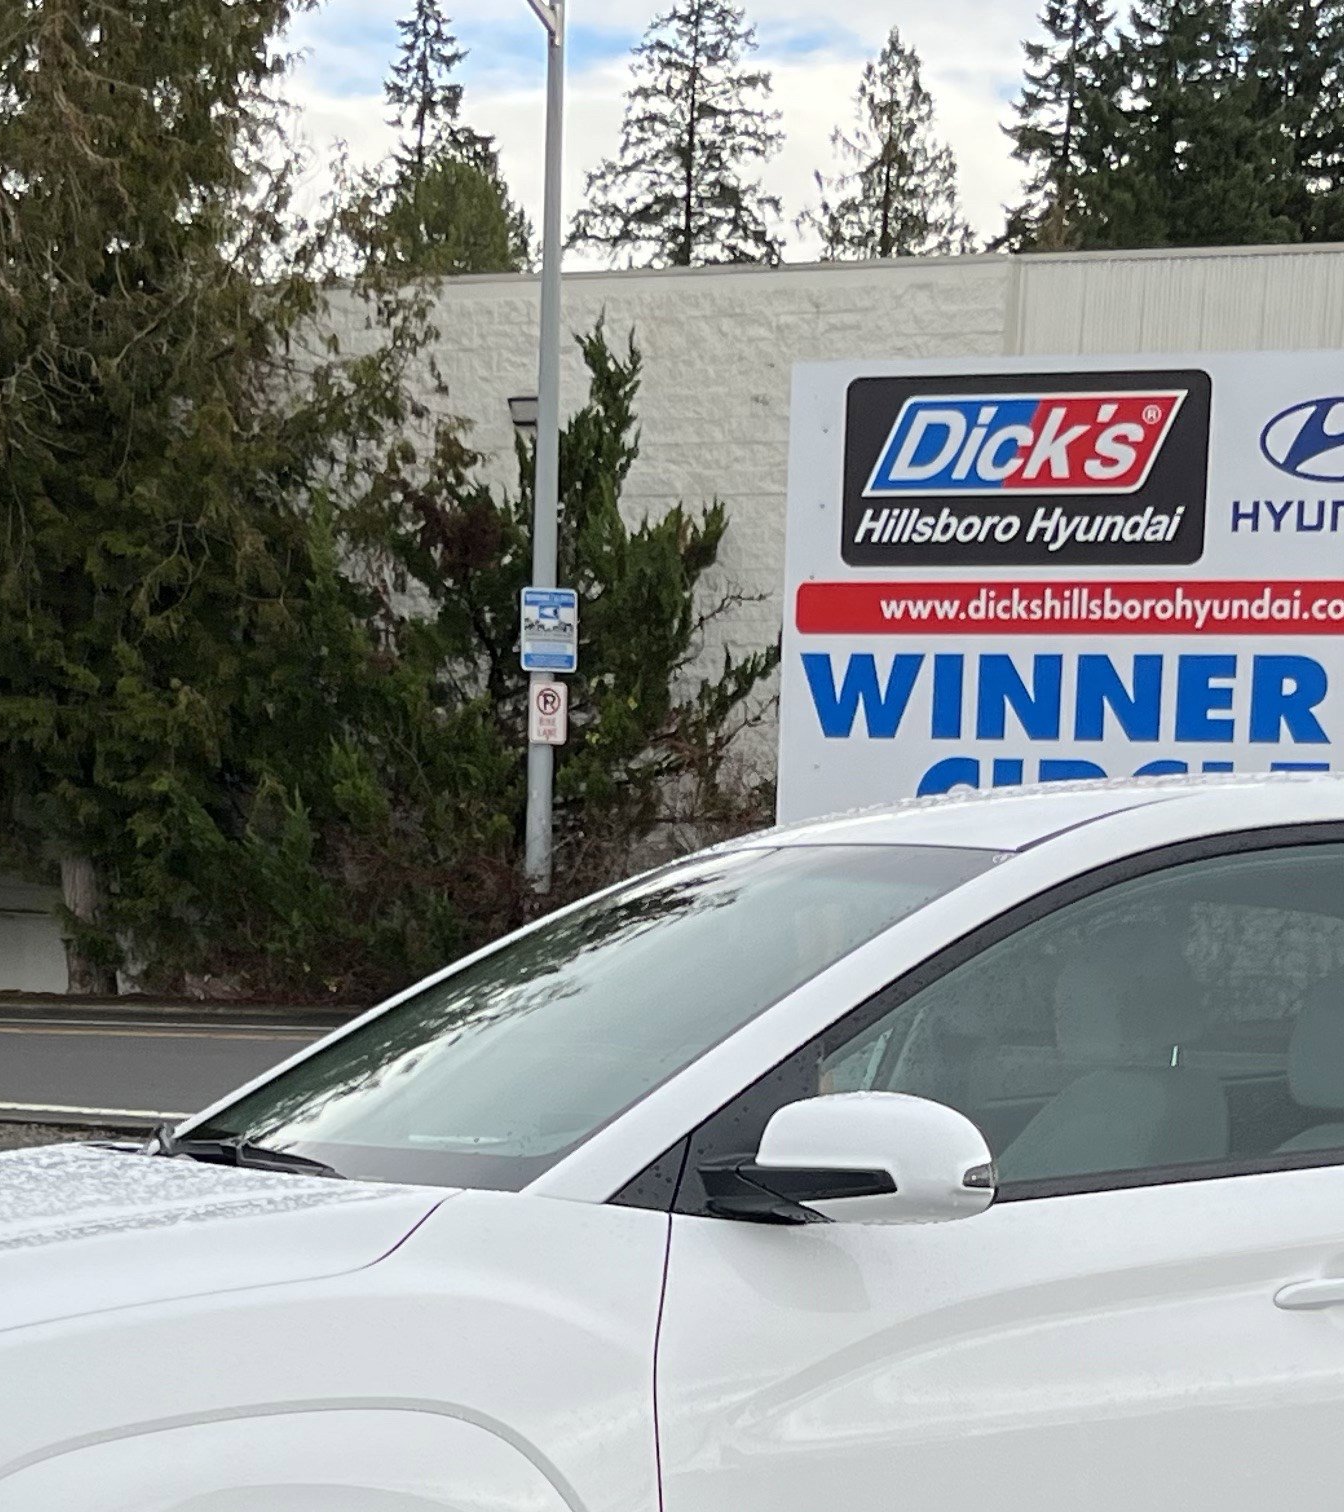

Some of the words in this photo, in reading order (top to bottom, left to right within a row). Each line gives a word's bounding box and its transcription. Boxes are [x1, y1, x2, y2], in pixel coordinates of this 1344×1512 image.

[888, 404, 1145, 481] Dick's
[854, 507, 1021, 543] Hillsboro
[1026, 506, 1186, 552] Hyundai
